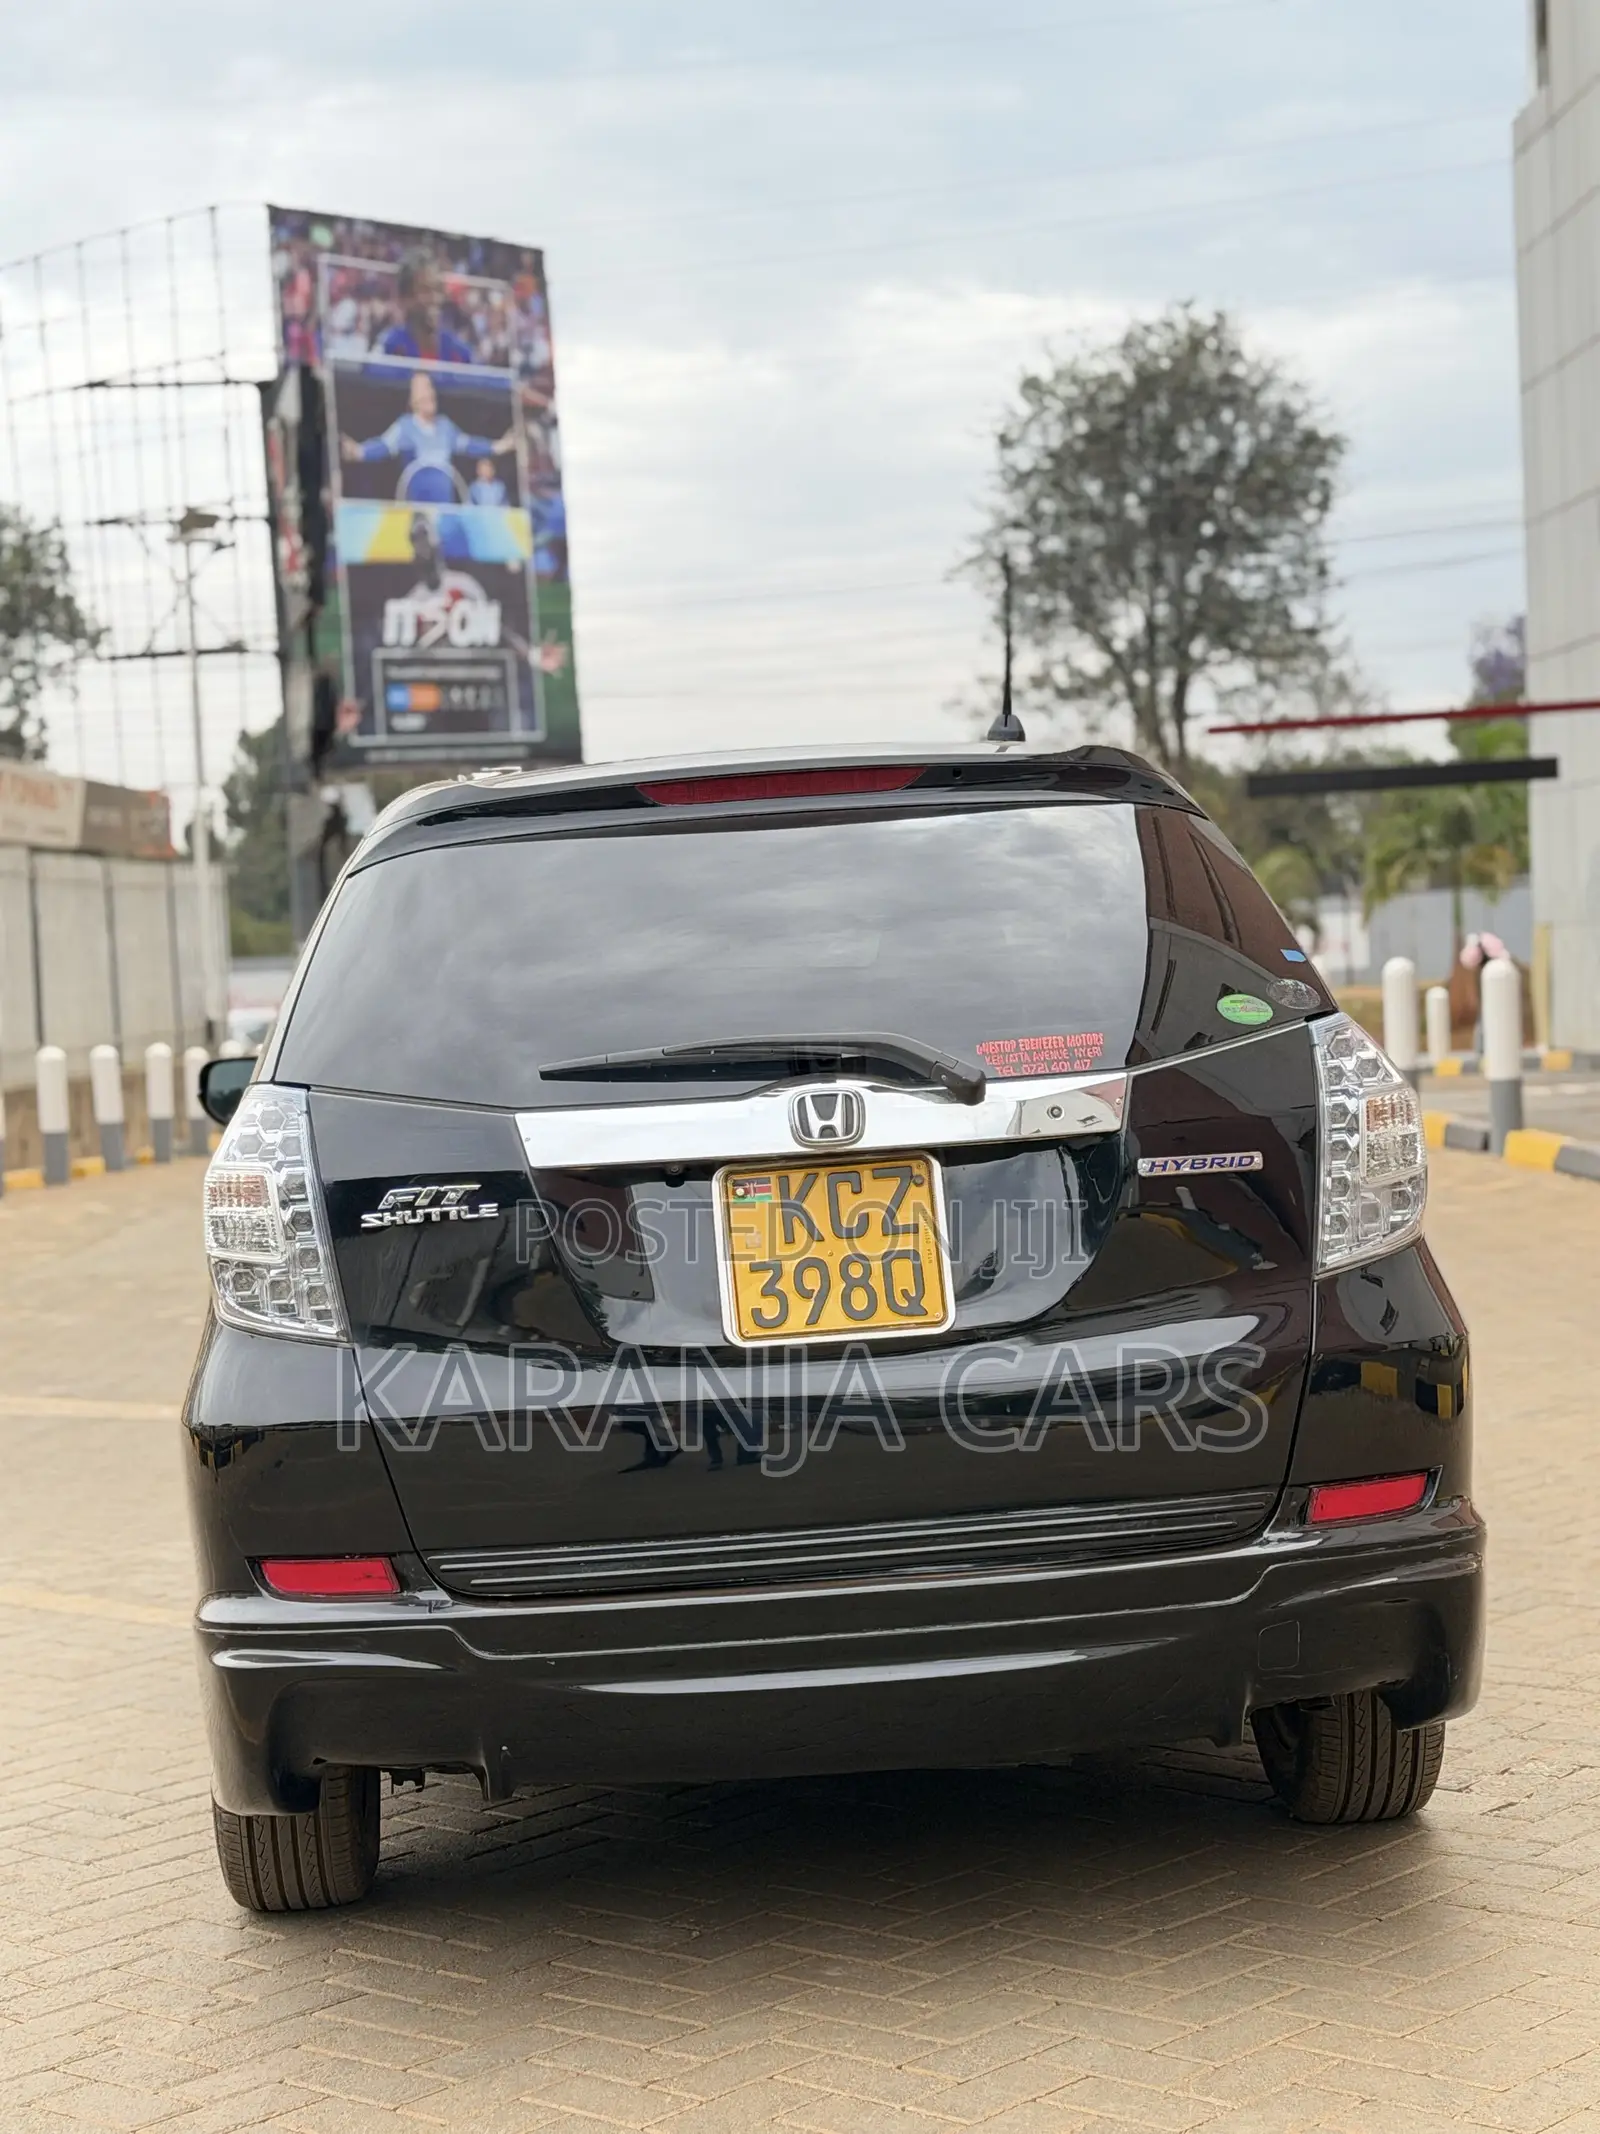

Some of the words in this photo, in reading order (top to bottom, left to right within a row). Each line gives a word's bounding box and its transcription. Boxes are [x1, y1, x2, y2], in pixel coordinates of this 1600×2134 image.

[1019, 1035, 1065, 1051] EBENEZER
[1066, 1032, 1104, 1047] MOTORS
[1148, 1155, 1255, 1173] HYBRID
[378, 1184, 482, 1209] FIT
[777, 1166, 920, 1244] KCZ
[360, 1203, 500, 1229] SHUTTLE
[749, 1248, 928, 1328] 398Q
